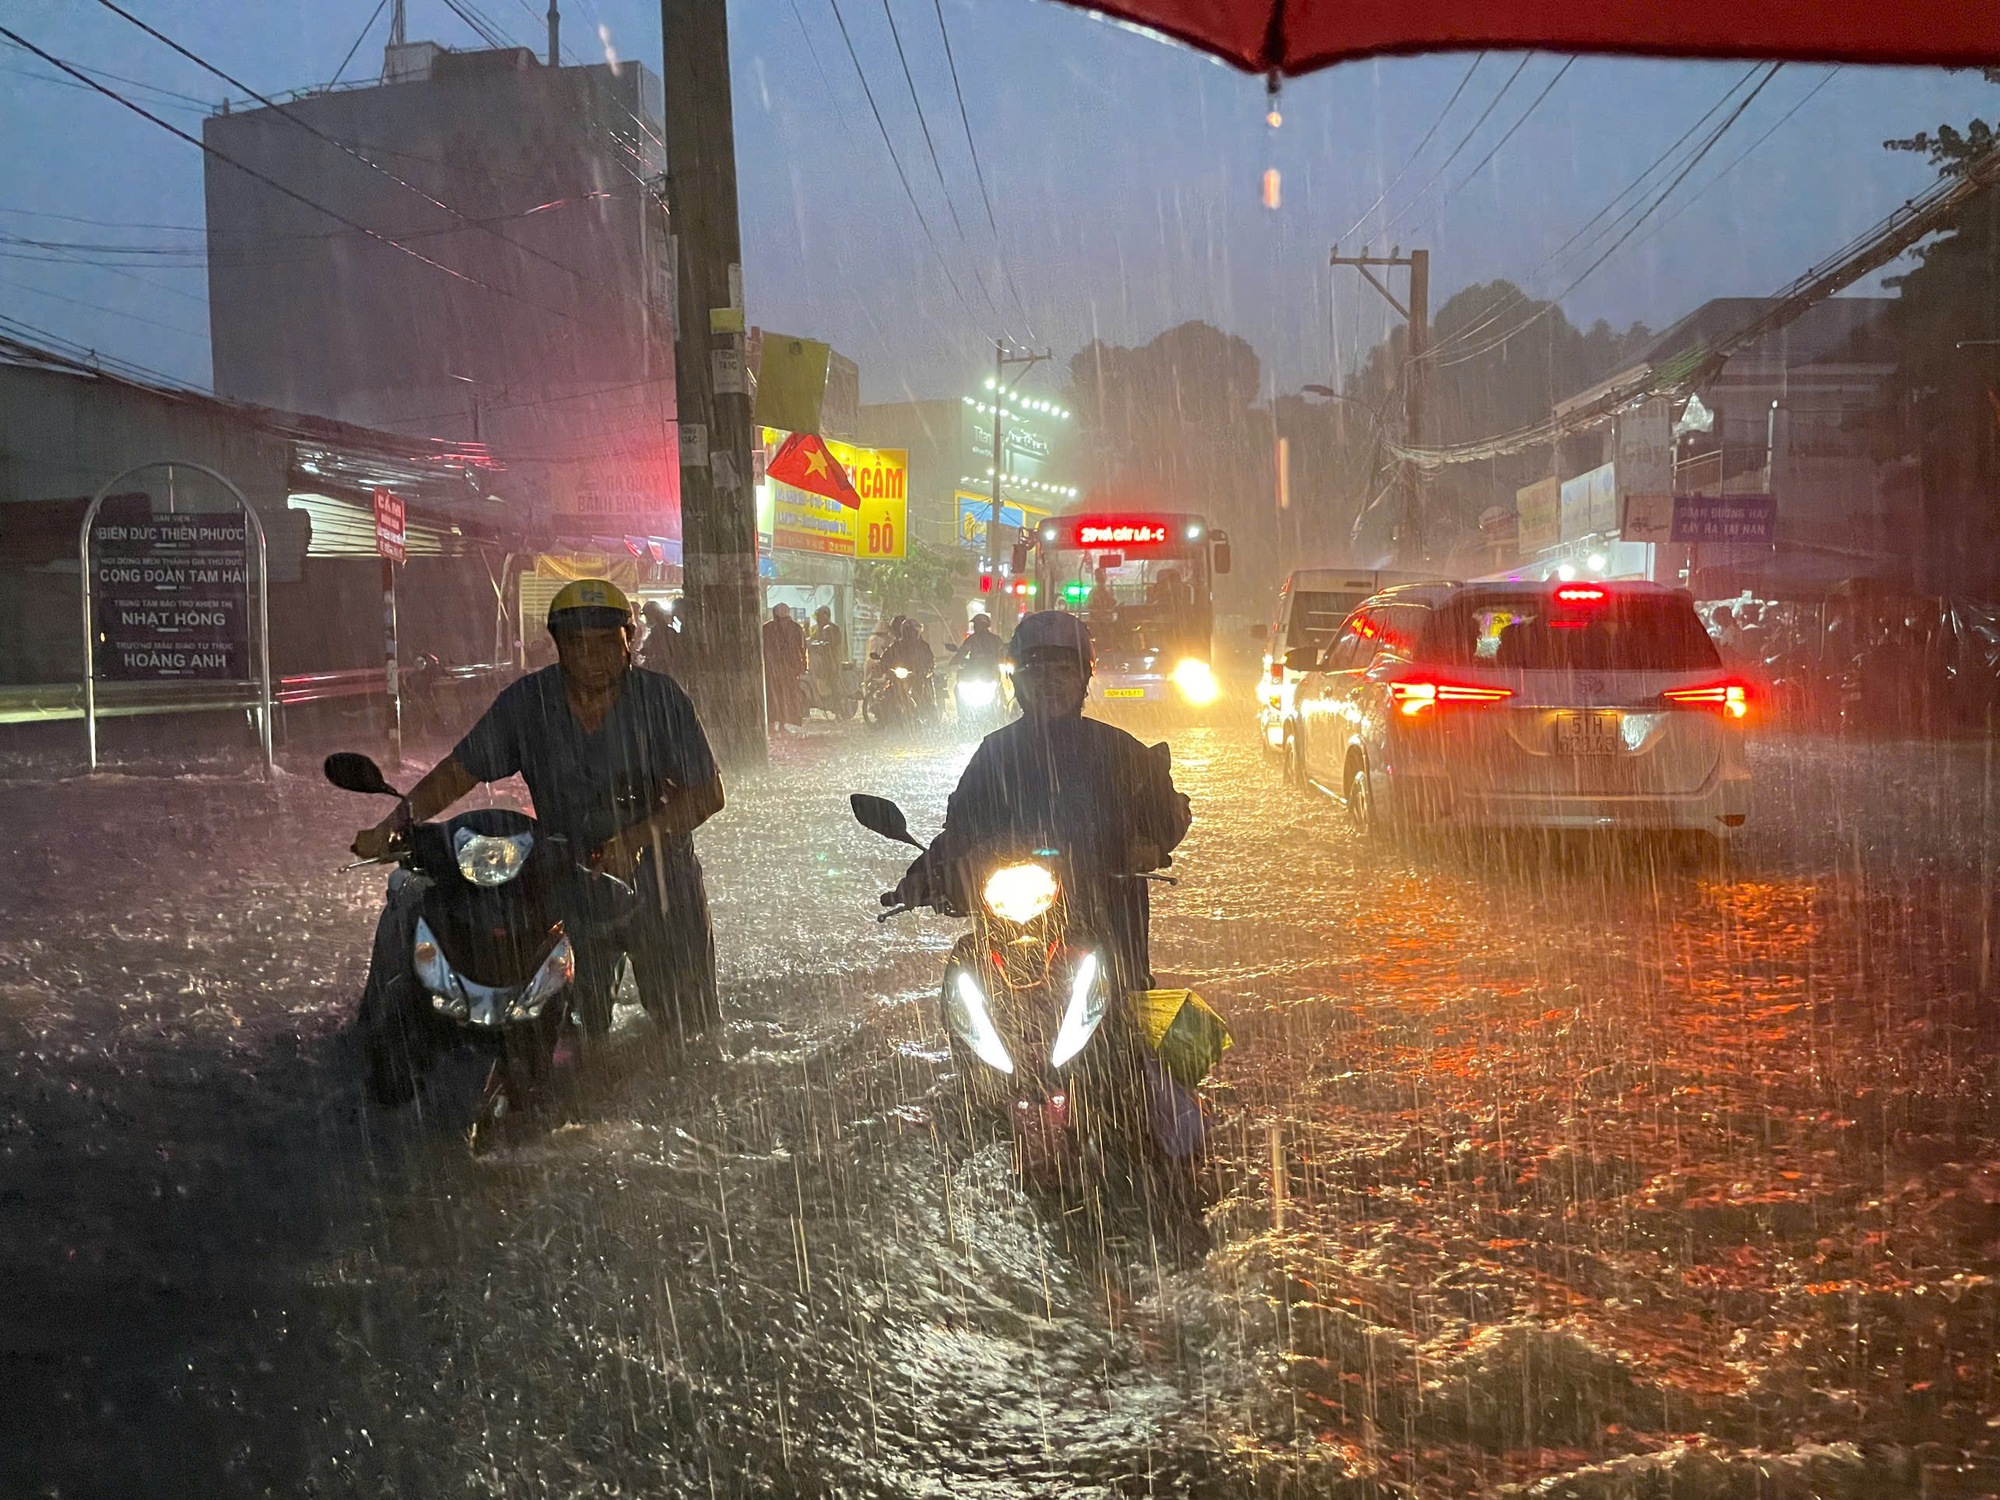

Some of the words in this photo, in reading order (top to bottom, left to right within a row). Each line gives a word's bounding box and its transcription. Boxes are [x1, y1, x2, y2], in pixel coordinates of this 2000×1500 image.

[861, 455, 903, 499] CẦM
[867, 510, 894, 554] ĐỒ
[144, 566, 185, 583] ĐOÀN
[124, 650, 186, 667] HOÀNG
[190, 653, 227, 668] ANH
[1572, 716, 1603, 735] 51H
